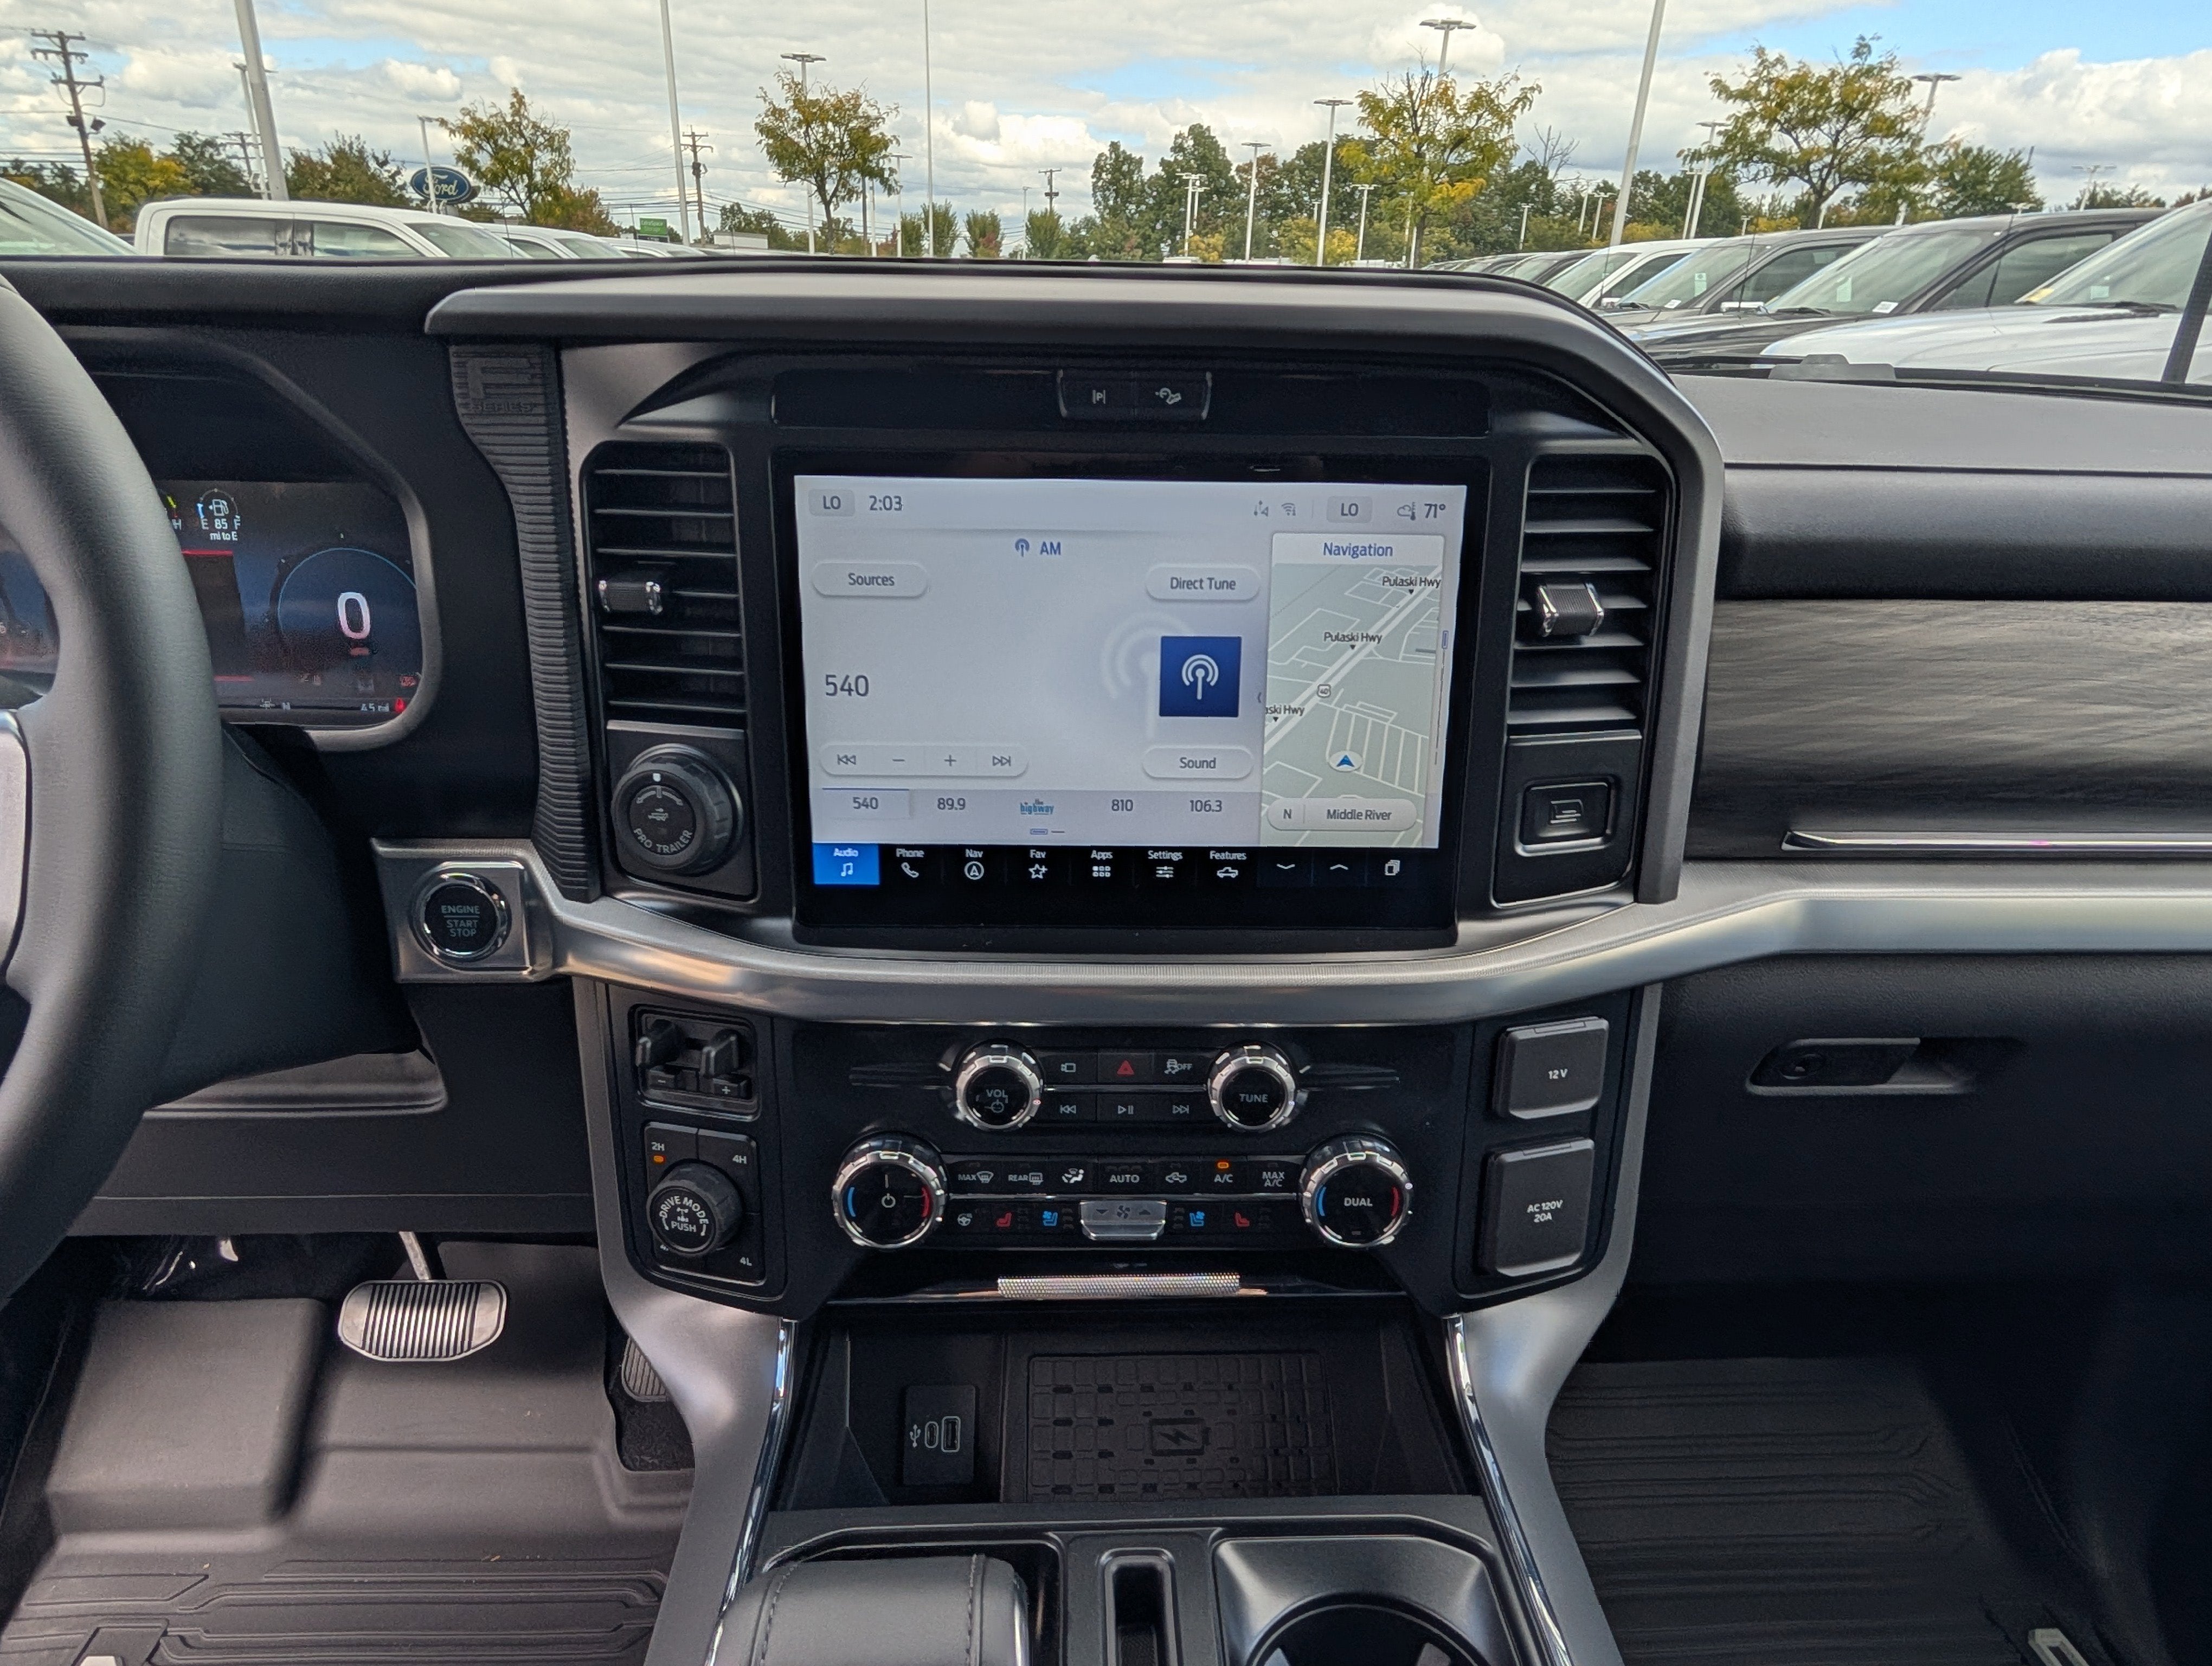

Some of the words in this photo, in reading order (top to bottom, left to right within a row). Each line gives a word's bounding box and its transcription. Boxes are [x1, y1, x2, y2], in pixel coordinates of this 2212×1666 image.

[422, 174, 458, 195] Ford
[822, 495, 841, 510] LO
[869, 495, 903, 511] 2:03
[1341, 503, 1359, 517] LO
[201, 518, 209, 530] E
[214, 518, 228, 529] 85
[234, 519, 241, 530] F
[210, 531, 221, 540] mi
[222, 531, 231, 540] to
[232, 531, 238, 541] E
[1040, 541, 1061, 555] AM
[1323, 543, 1393, 559] Navigation
[848, 573, 895, 586] Sources
[1170, 576, 1204, 590] Direct
[1206, 578, 1236, 591] Tune
[1382, 576, 1417, 587] Pulaski
[1419, 576, 1441, 588] Hwy
[337, 592, 371, 639] 0
[1323, 632, 1359, 642] Pulaski
[1361, 632, 1382, 644] Hwy
[825, 674, 870, 697] 540
[1283, 705, 1305, 716] Hwy
[1179, 757, 1217, 770] Sound
[852, 797, 879, 810] 540
[937, 797, 966, 811] 89.9
[1111, 798, 1133, 812] 810
[1189, 800, 1223, 812] 106.3
[1283, 809, 1292, 819] N
[1327, 809, 1363, 820] Middle
[1365, 809, 1392, 821] River
[633, 828, 653, 848] PRO
[655, 829, 693, 854] TRAILER
[833, 847, 859, 858] Audio
[896, 848, 924, 858] Phone
[965, 849, 983, 858] Nav
[1030, 850, 1046, 859] Fav
[1091, 849, 1113, 861] Apps
[1148, 850, 1183, 862] Settings
[1210, 850, 1247, 860] Features
[441, 905, 480, 914] ENGINE
[446, 919, 479, 928] START
[450, 928, 477, 937] STOP
[1178, 1063, 1193, 1072] OFF
[986, 1089, 1006, 1098] VOL
[1239, 1093, 1268, 1103] TUNE
[651, 1142, 665, 1151] 2H
[732, 1155, 747, 1164] 4H
[1110, 1174, 1140, 1183] AUTO
[1214, 1174, 1233, 1183] A/C
[1262, 1171, 1285, 1180] MAX
[1264, 1178, 1283, 1187] A/C
[1343, 1197, 1373, 1207] DUAL
[1527, 1203, 1540, 1213] AC
[1541, 1200, 1564, 1211] 120V
[659, 1195, 680, 1219] DRIVE
[683, 1196, 709, 1225] MODE
[1534, 1212, 1552, 1223] 20A
[671, 1220, 697, 1233] PUSH
[740, 1257, 753, 1266] 4L
